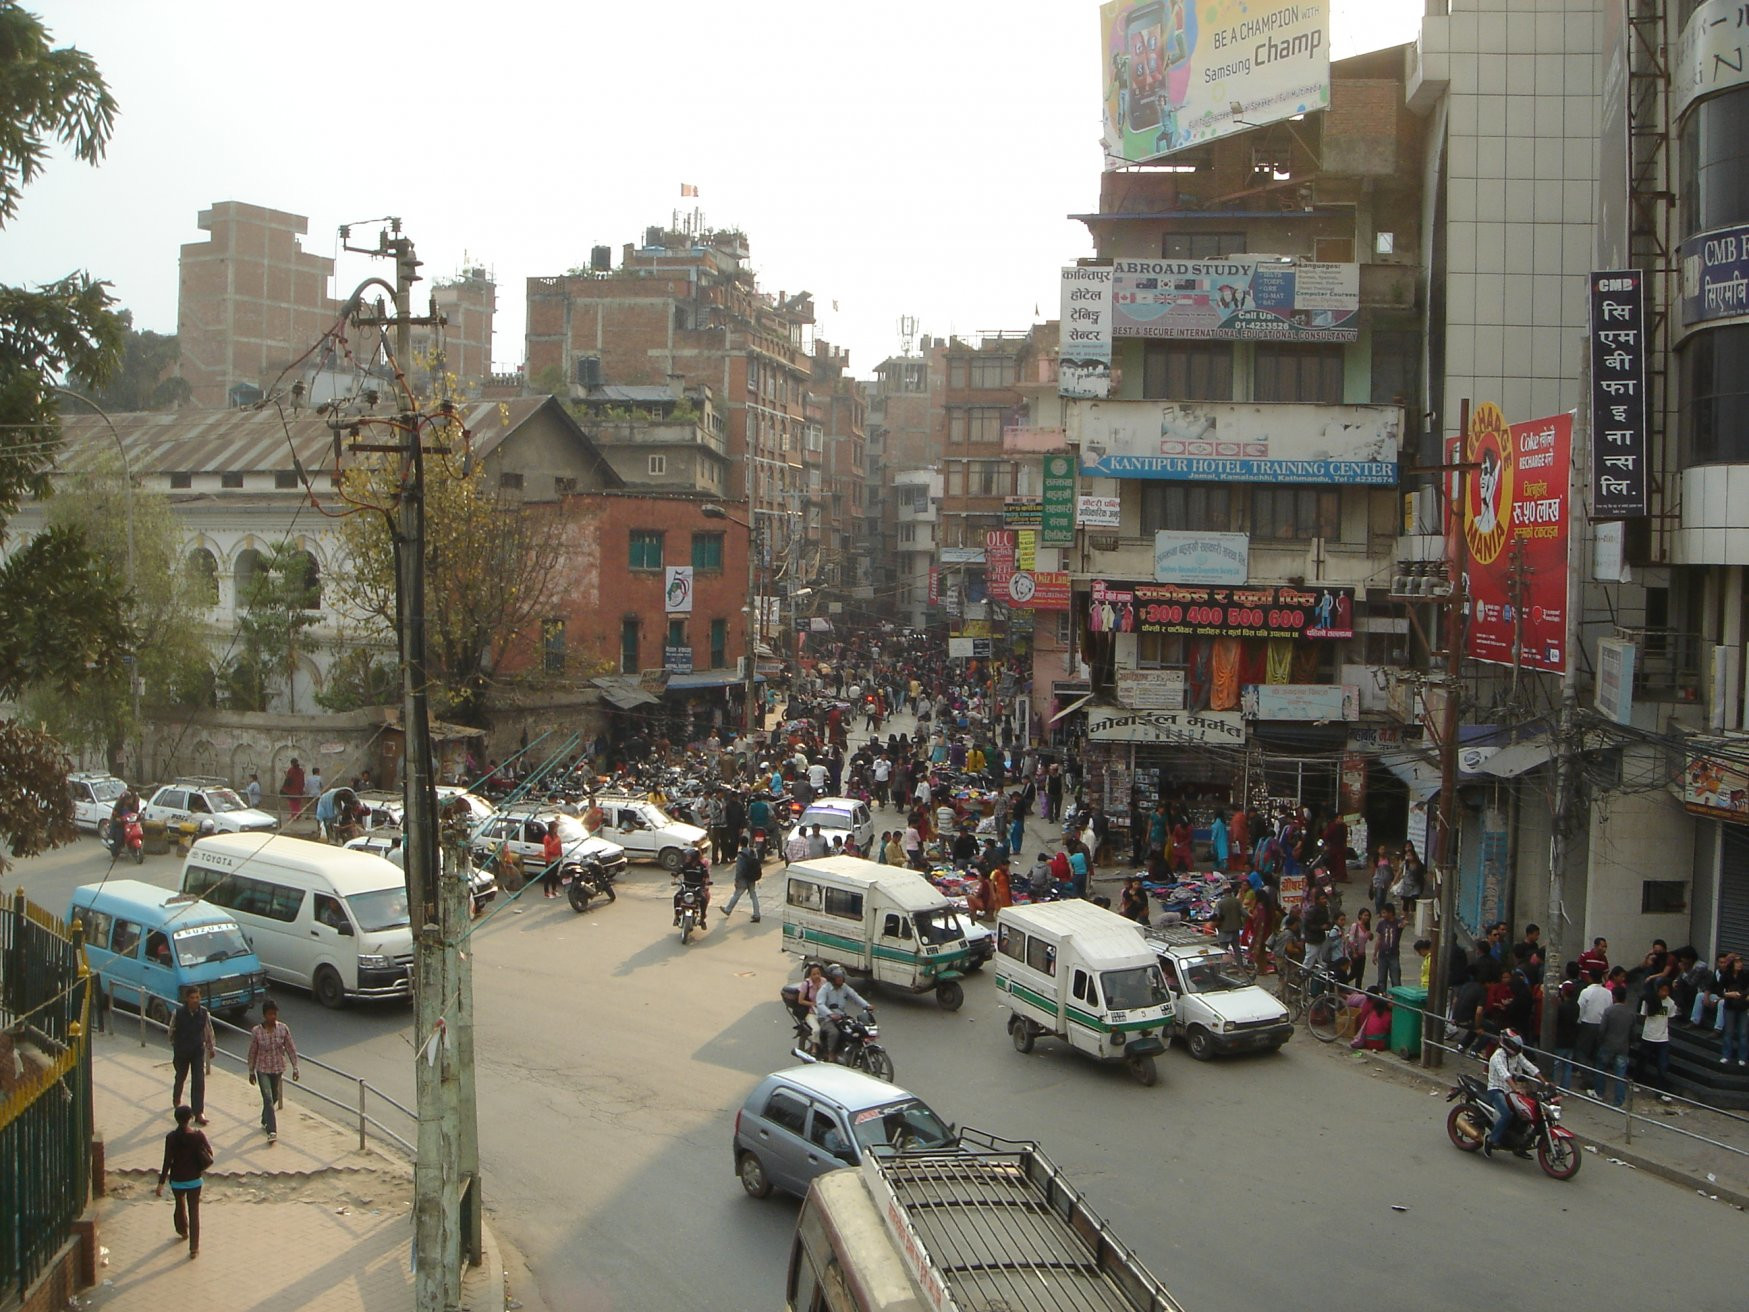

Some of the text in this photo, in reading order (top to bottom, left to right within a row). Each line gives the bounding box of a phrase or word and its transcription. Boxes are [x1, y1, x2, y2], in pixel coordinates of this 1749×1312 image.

[1214, 5, 1320, 50] BE A CHAMPION WITH
[1204, 29, 1322, 84] Samsung Champ
[1704, 236, 1737, 267] CMB
[1114, 262, 1251, 276] ABROAD STUDY
[1300, 262, 1341, 270] Languages:
[1062, 267, 1112, 283] कान्तिपुर
[1598, 278, 1633, 292] CMB
[1070, 287, 1102, 301] होटेल
[1295, 290, 1329, 298] Computer
[1238, 311, 1257, 320] Call
[1069, 327, 1102, 341] सेन्टर
[1112, 326, 1135, 336] BEST
[1146, 327, 1174, 337] SECURE
[1176, 328, 1239, 338] INTERNATIONAL
[1242, 329, 1297, 340] EDUCATIONAL
[1300, 330, 1358, 341] CONSULTANCY
[1520, 432, 1539, 452] Coke
[1110, 456, 1393, 477] KANTIPUR HOTEL TRAINING CENTER
[1188, 472, 1218, 481] Jamal,
[1278, 475, 1331, 484] Kathmandu,
[986, 530, 1013, 547] OLC
[1466, 518, 1506, 562] MANIA
[1214, 589, 1230, 604] र
[1147, 604, 1183, 623] 300
[1187, 606, 1223, 625] 400
[1228, 608, 1264, 627] 500
[1268, 610, 1305, 628] 600
[201, 853, 233, 867] TOYOTA
